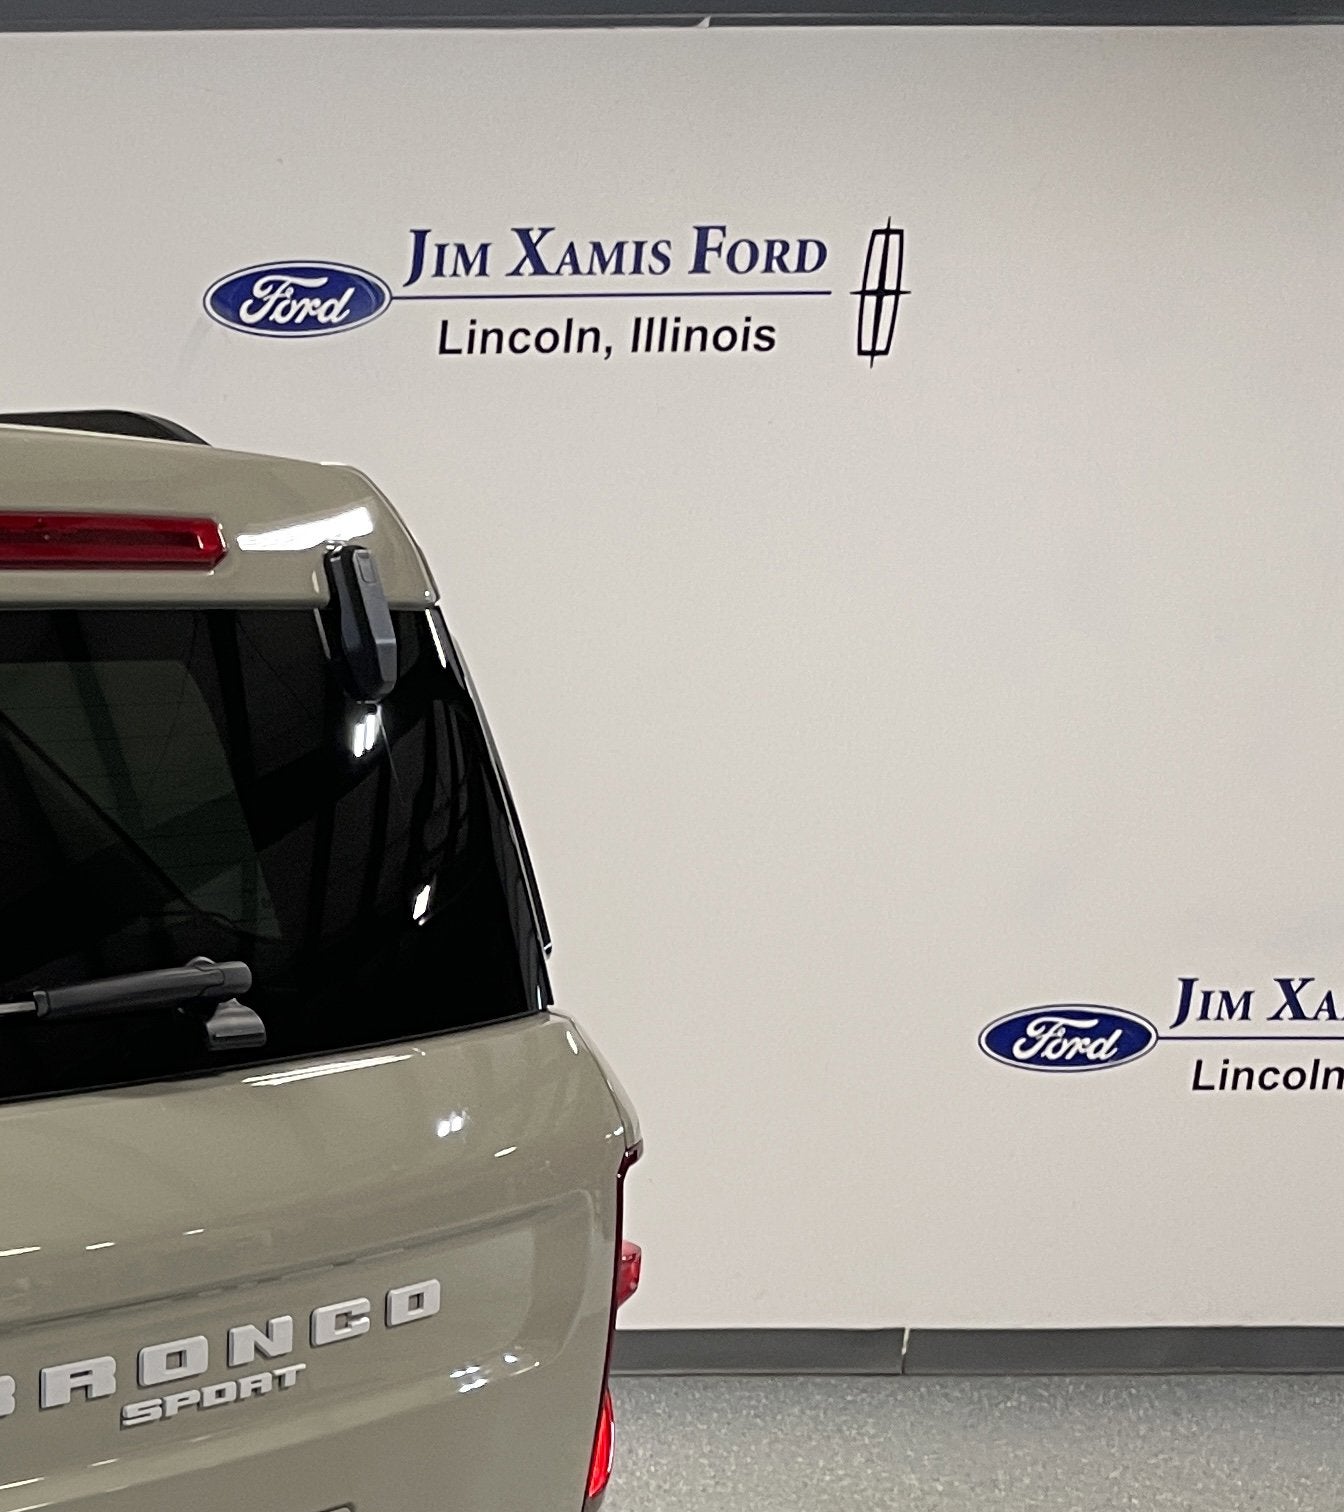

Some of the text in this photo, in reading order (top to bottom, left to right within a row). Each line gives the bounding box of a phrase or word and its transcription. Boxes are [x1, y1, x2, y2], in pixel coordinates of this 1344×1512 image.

[403, 225, 828, 288] JIM XAMIS FORD
[239, 274, 355, 327] Ford
[438, 316, 777, 361] Lincoln, Illinois
[1169, 977, 1344, 1030] JIM XA
[1013, 1015, 1123, 1061] Ford
[121, 1363, 307, 1429] SPORT
